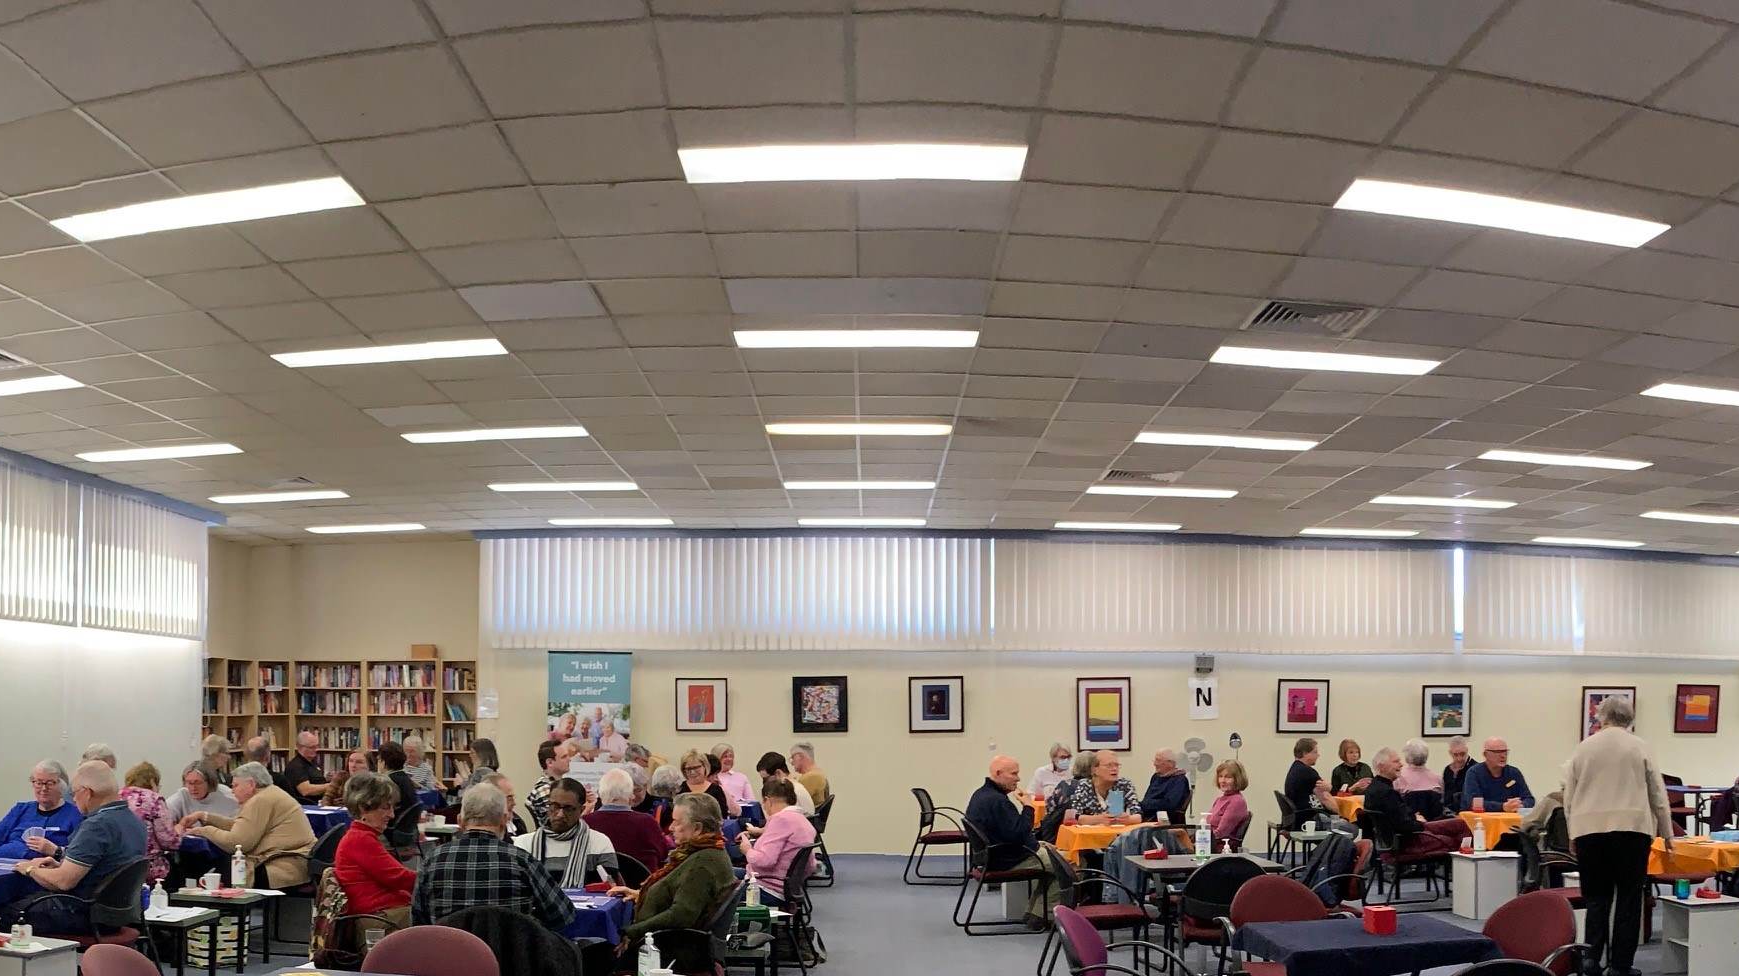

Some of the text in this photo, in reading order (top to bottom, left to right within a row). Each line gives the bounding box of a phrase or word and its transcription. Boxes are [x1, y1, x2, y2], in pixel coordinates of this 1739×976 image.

[580, 661, 603, 670] wish
[604, 661, 608, 670] I
[562, 673, 616, 683] had moved
[1196, 687, 1212, 707] N
